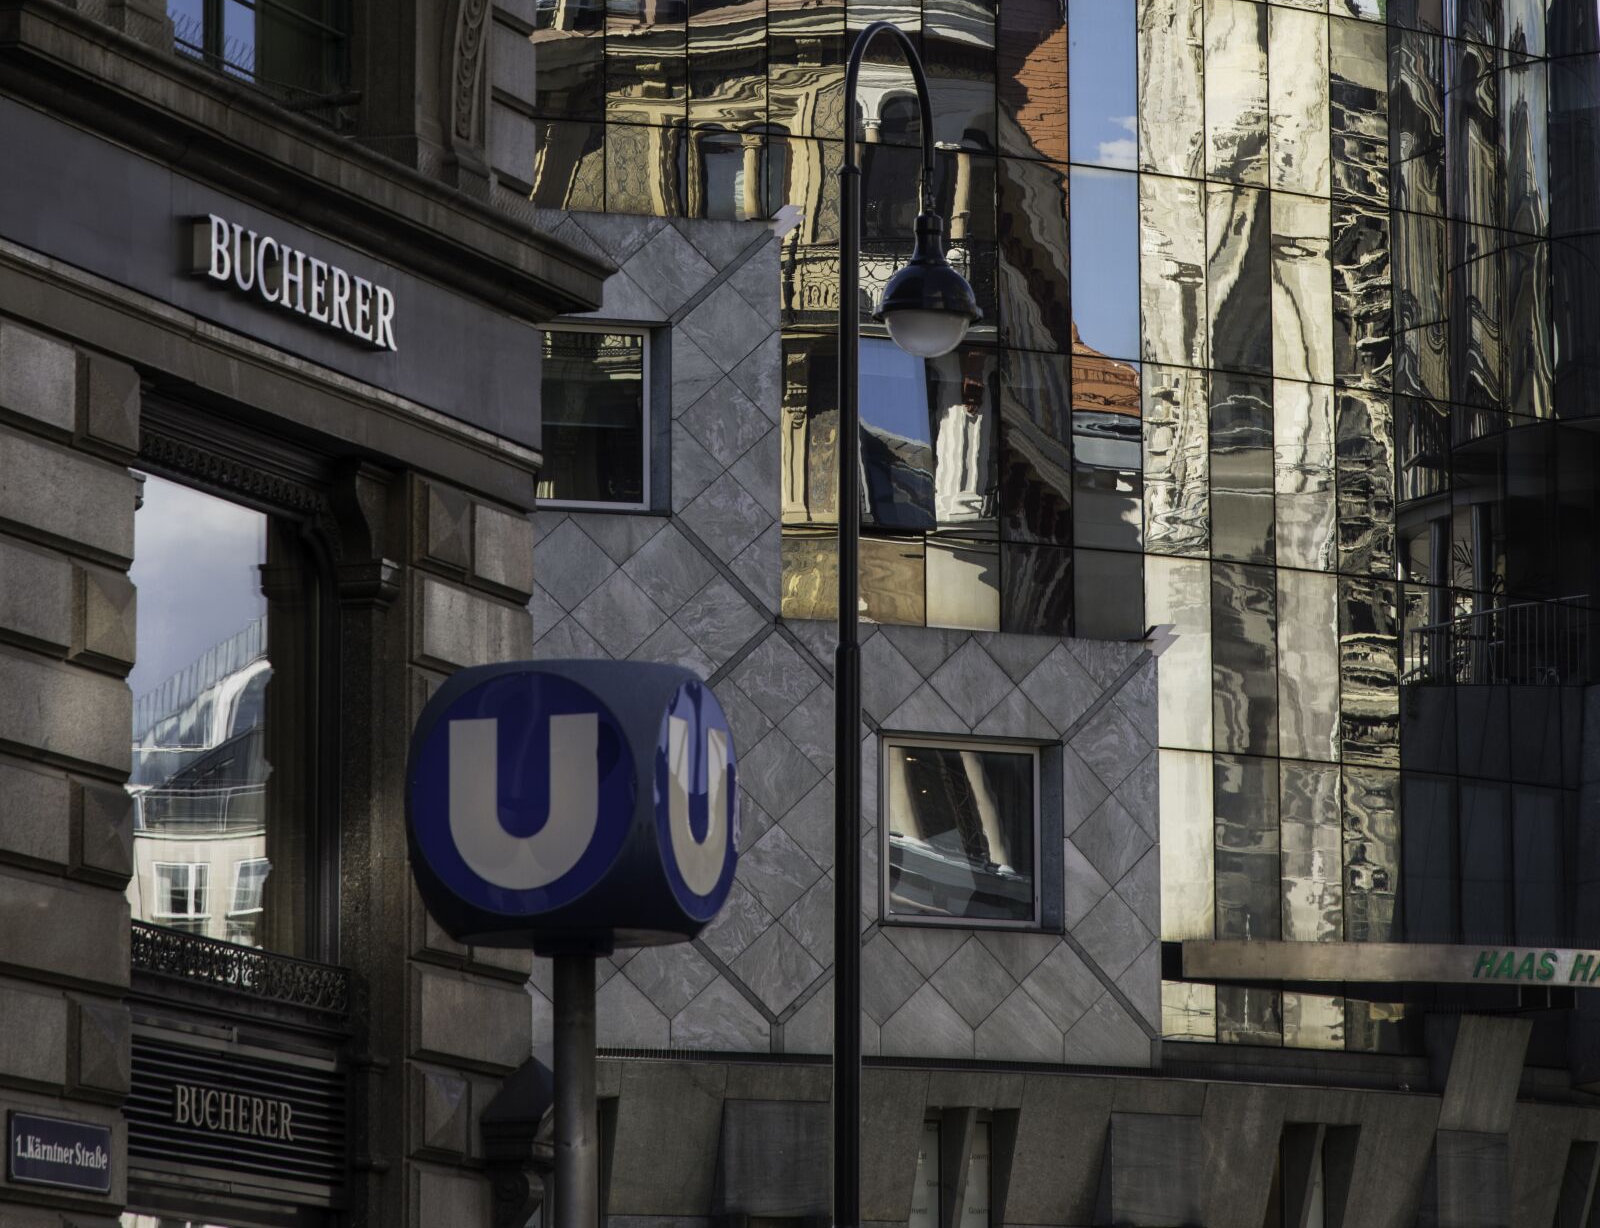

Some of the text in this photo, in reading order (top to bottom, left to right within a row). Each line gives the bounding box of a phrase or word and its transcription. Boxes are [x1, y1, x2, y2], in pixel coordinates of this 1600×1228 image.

[208, 213, 397, 351] BUCHERER
[449, 712, 599, 891] U
[668, 715, 728, 897] U
[1472, 950, 1558, 981] HAAS
[75, 1141, 108, 1169] Straße
[175, 1084, 294, 1141] BUCHERER
